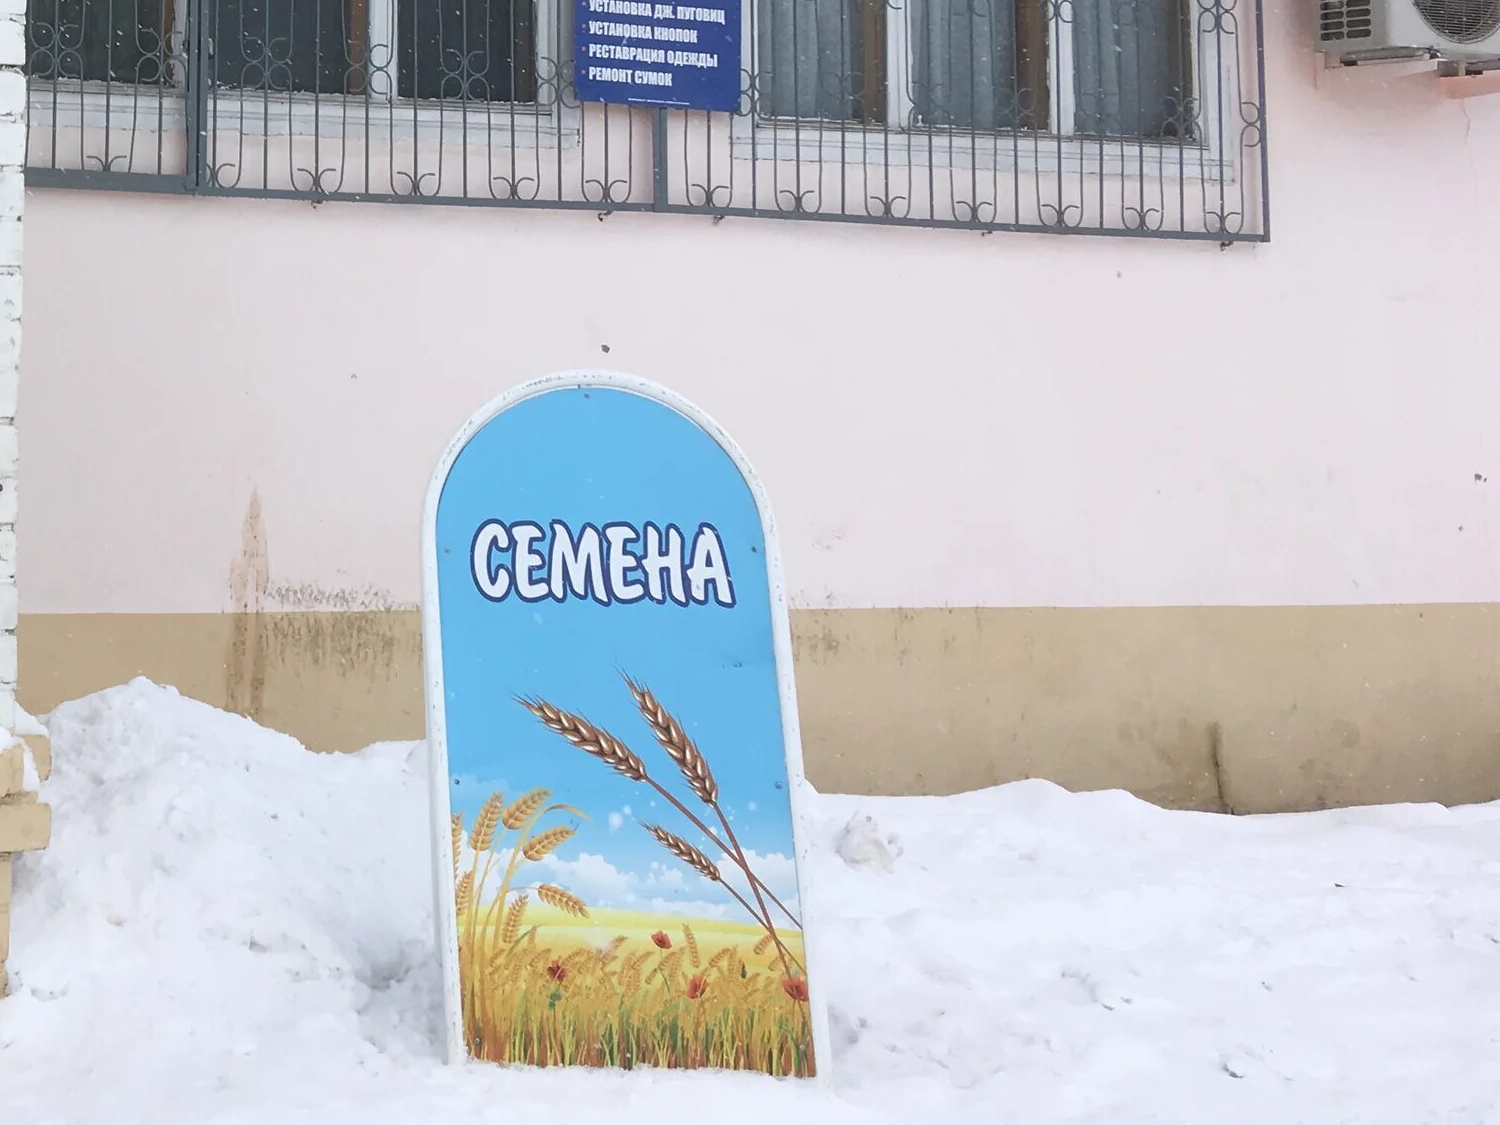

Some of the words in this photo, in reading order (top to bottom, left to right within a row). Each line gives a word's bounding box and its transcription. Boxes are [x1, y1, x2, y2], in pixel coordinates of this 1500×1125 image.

[653, 2, 675, 20] ДЖ.
[676, 6, 726, 25] ПУГОВИЦ
[589, 20, 653, 40] УСТАНОВКА
[653, 25, 698, 43] КНОПОК
[588, 43, 665, 65] РЕСТАВРАЦИЯ
[666, 49, 718, 68] ОДЕЖДЫ
[588, 67, 633, 84] РЕМОНТ
[634, 70, 673, 87] СУМОК
[469, 518, 737, 608] СЕМЕНА
